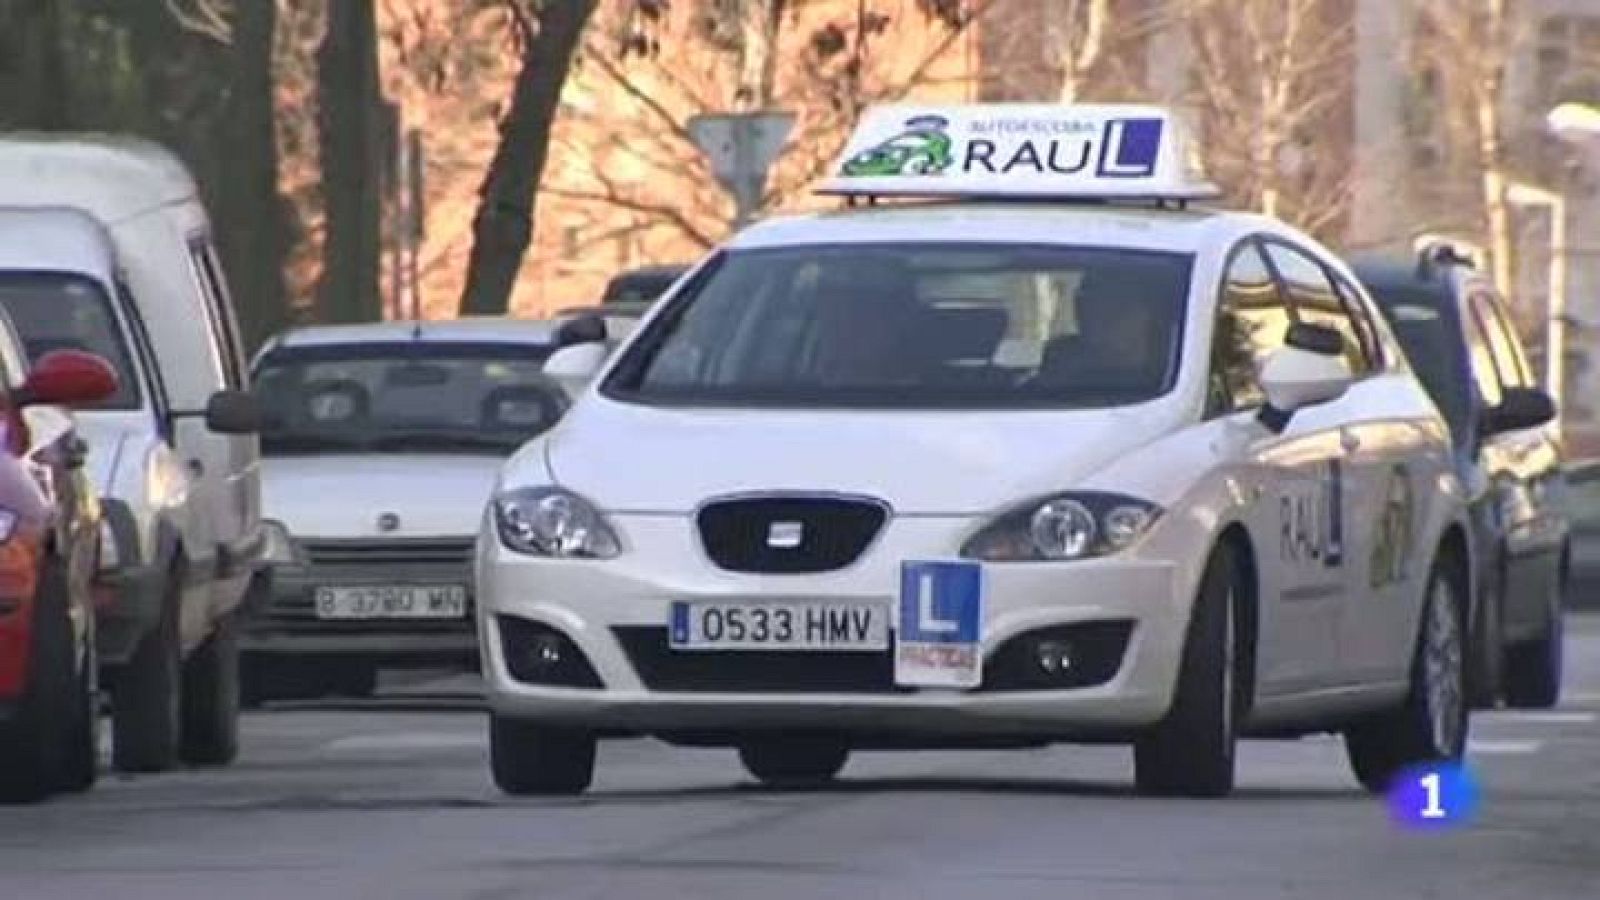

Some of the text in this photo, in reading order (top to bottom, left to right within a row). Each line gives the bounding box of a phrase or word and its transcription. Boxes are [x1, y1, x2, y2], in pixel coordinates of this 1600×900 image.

[702, 607, 872, 641] 0533 HMV
[919, 574, 960, 632] L
